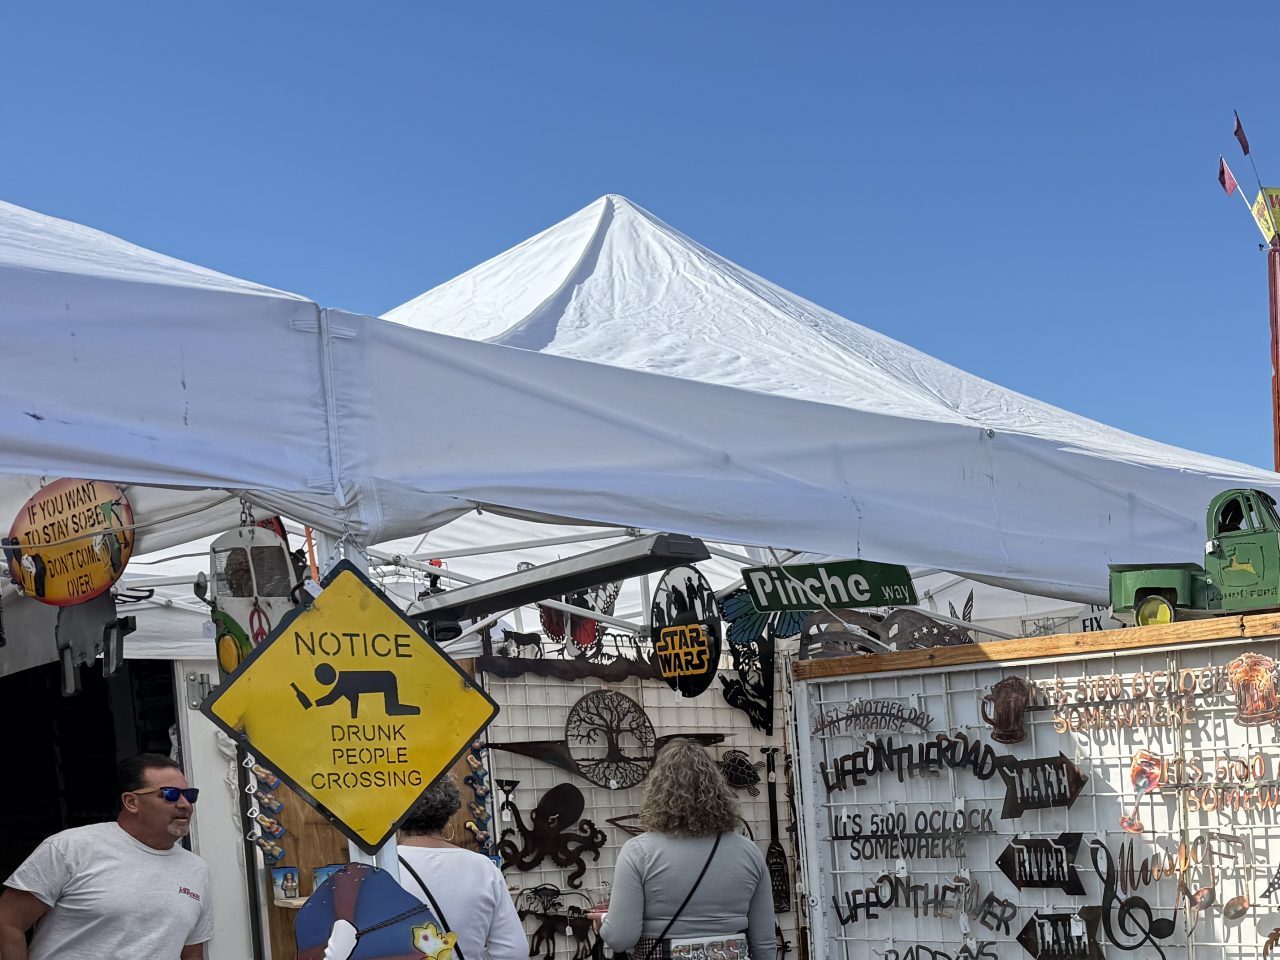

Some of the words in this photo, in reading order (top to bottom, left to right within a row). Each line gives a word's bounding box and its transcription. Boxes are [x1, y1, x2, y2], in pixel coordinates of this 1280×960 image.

[27, 505, 38, 525] IF
[39, 496, 65, 520] YOU
[66, 481, 98, 511] WANT
[24, 529, 42, 550] TO
[42, 519, 71, 544] STAY
[47, 554, 74, 579] DON'T
[66, 574, 95, 598] OVER!
[749, 567, 872, 607] Pinche
[880, 581, 911, 603] way
[1082, 616, 1104, 632] FIX
[294, 631, 413, 659] NOTICE
[656, 625, 707, 652] STAR
[658, 648, 708, 677] WARS
[829, 720, 842, 737] IN
[845, 715, 908, 733] PARADISE
[847, 700, 905, 719] ANOTHER
[907, 706, 935, 731] DAY
[1053, 700, 1198, 735] SOMEWHERE
[331, 724, 407, 742] DRUNK
[332, 747, 409, 765] PEOPLE
[311, 770, 422, 789] CROSSING
[914, 808, 994, 834] OCLOCK
[850, 836, 968, 861] SOMEWHERE
